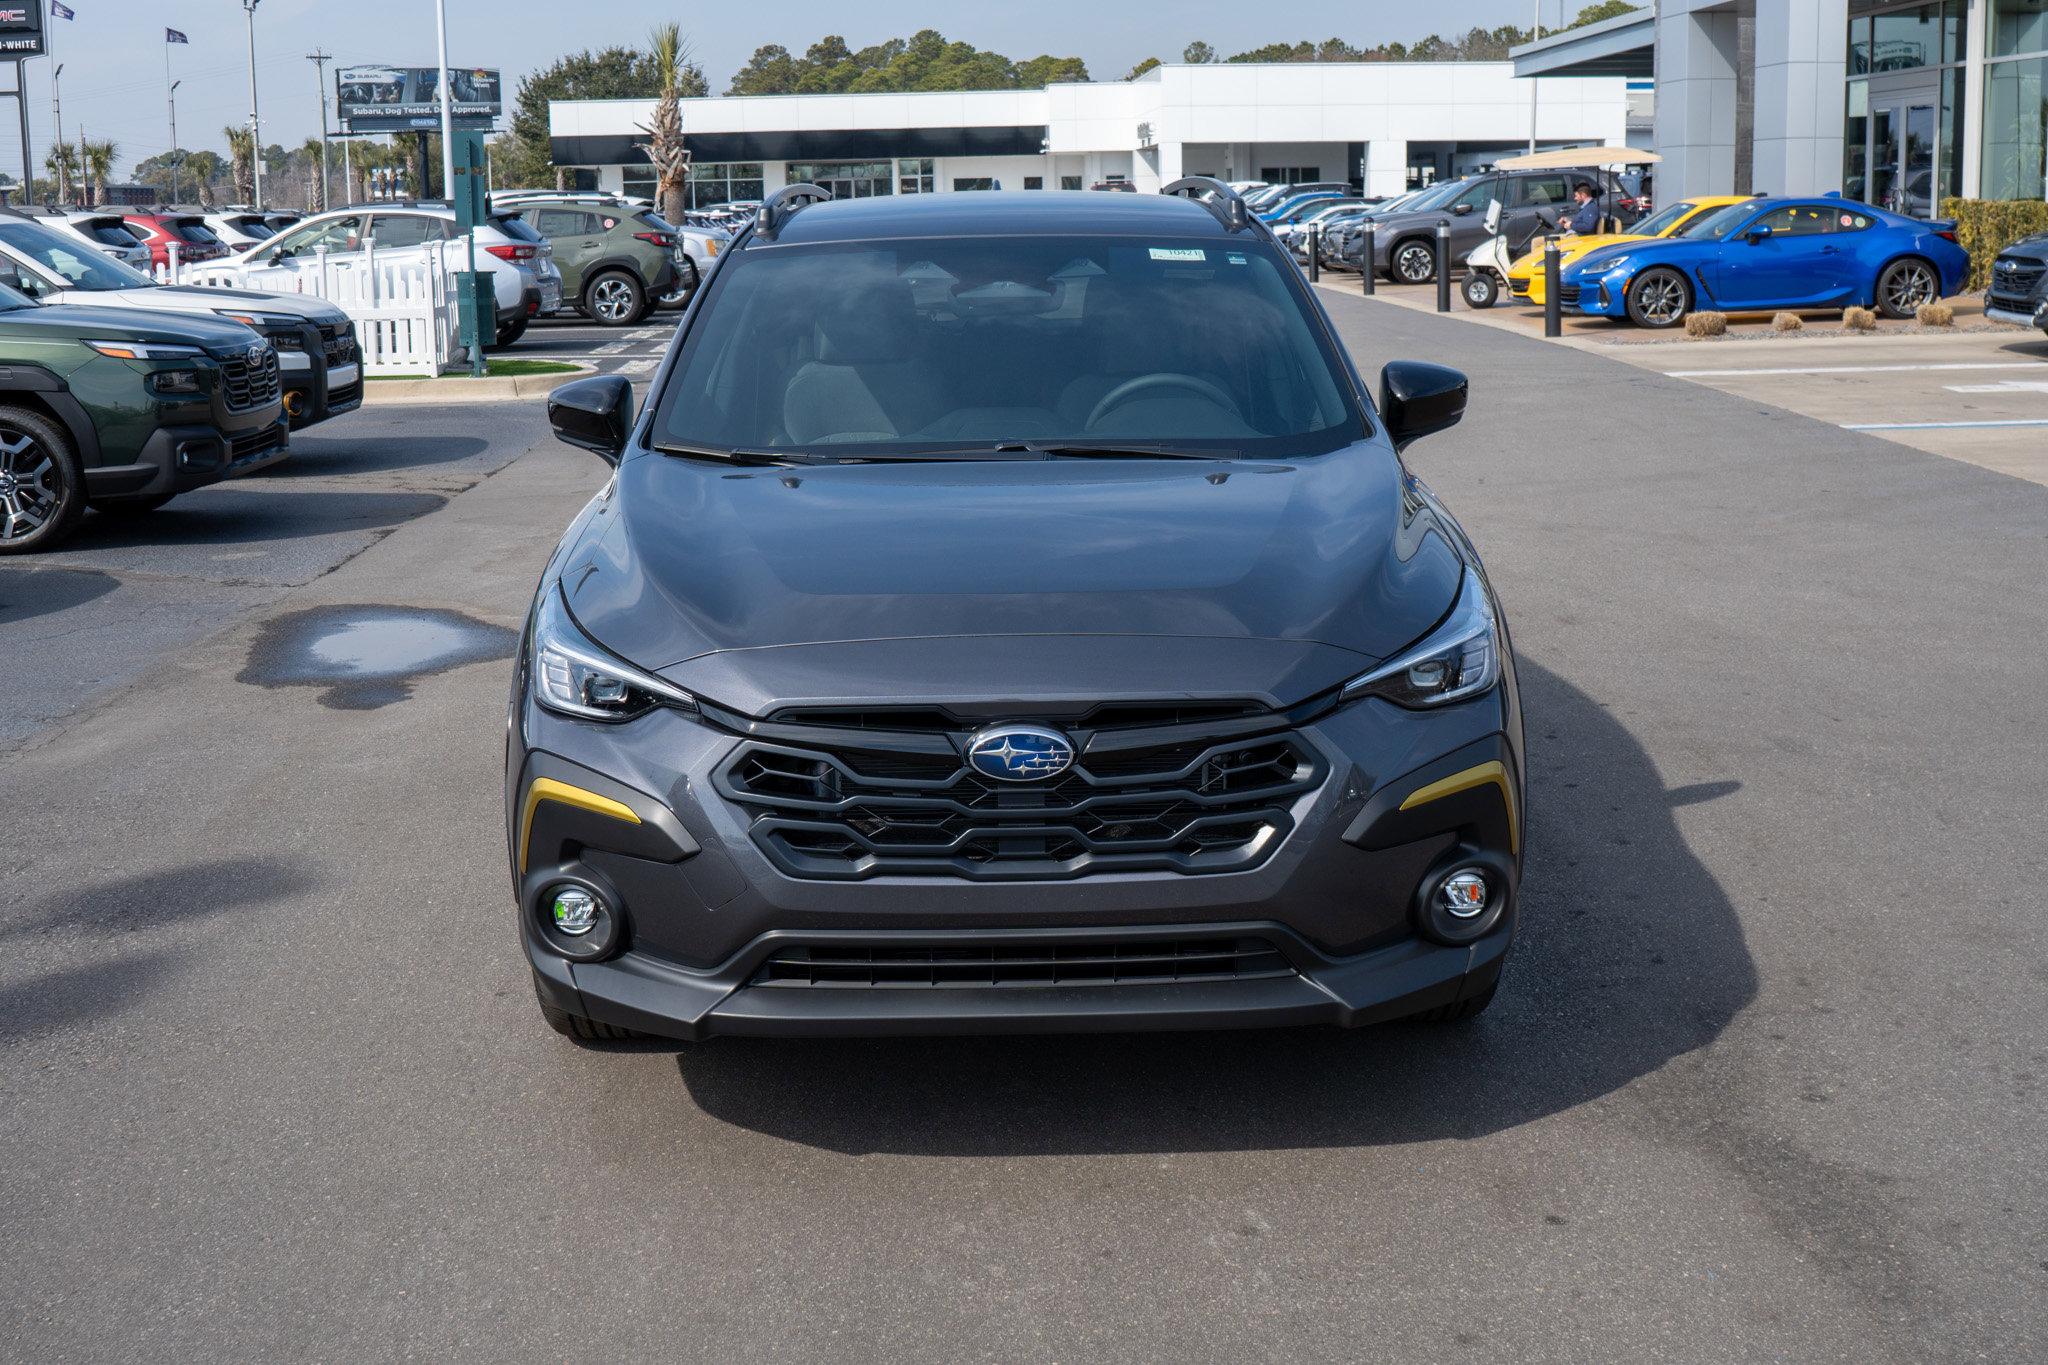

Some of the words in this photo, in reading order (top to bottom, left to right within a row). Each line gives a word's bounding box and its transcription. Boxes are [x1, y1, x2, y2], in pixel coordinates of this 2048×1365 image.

[0, 40, 37, 49] -WHITE
[353, 107, 384, 115] Subaru,
[404, 106, 432, 114] Tested.
